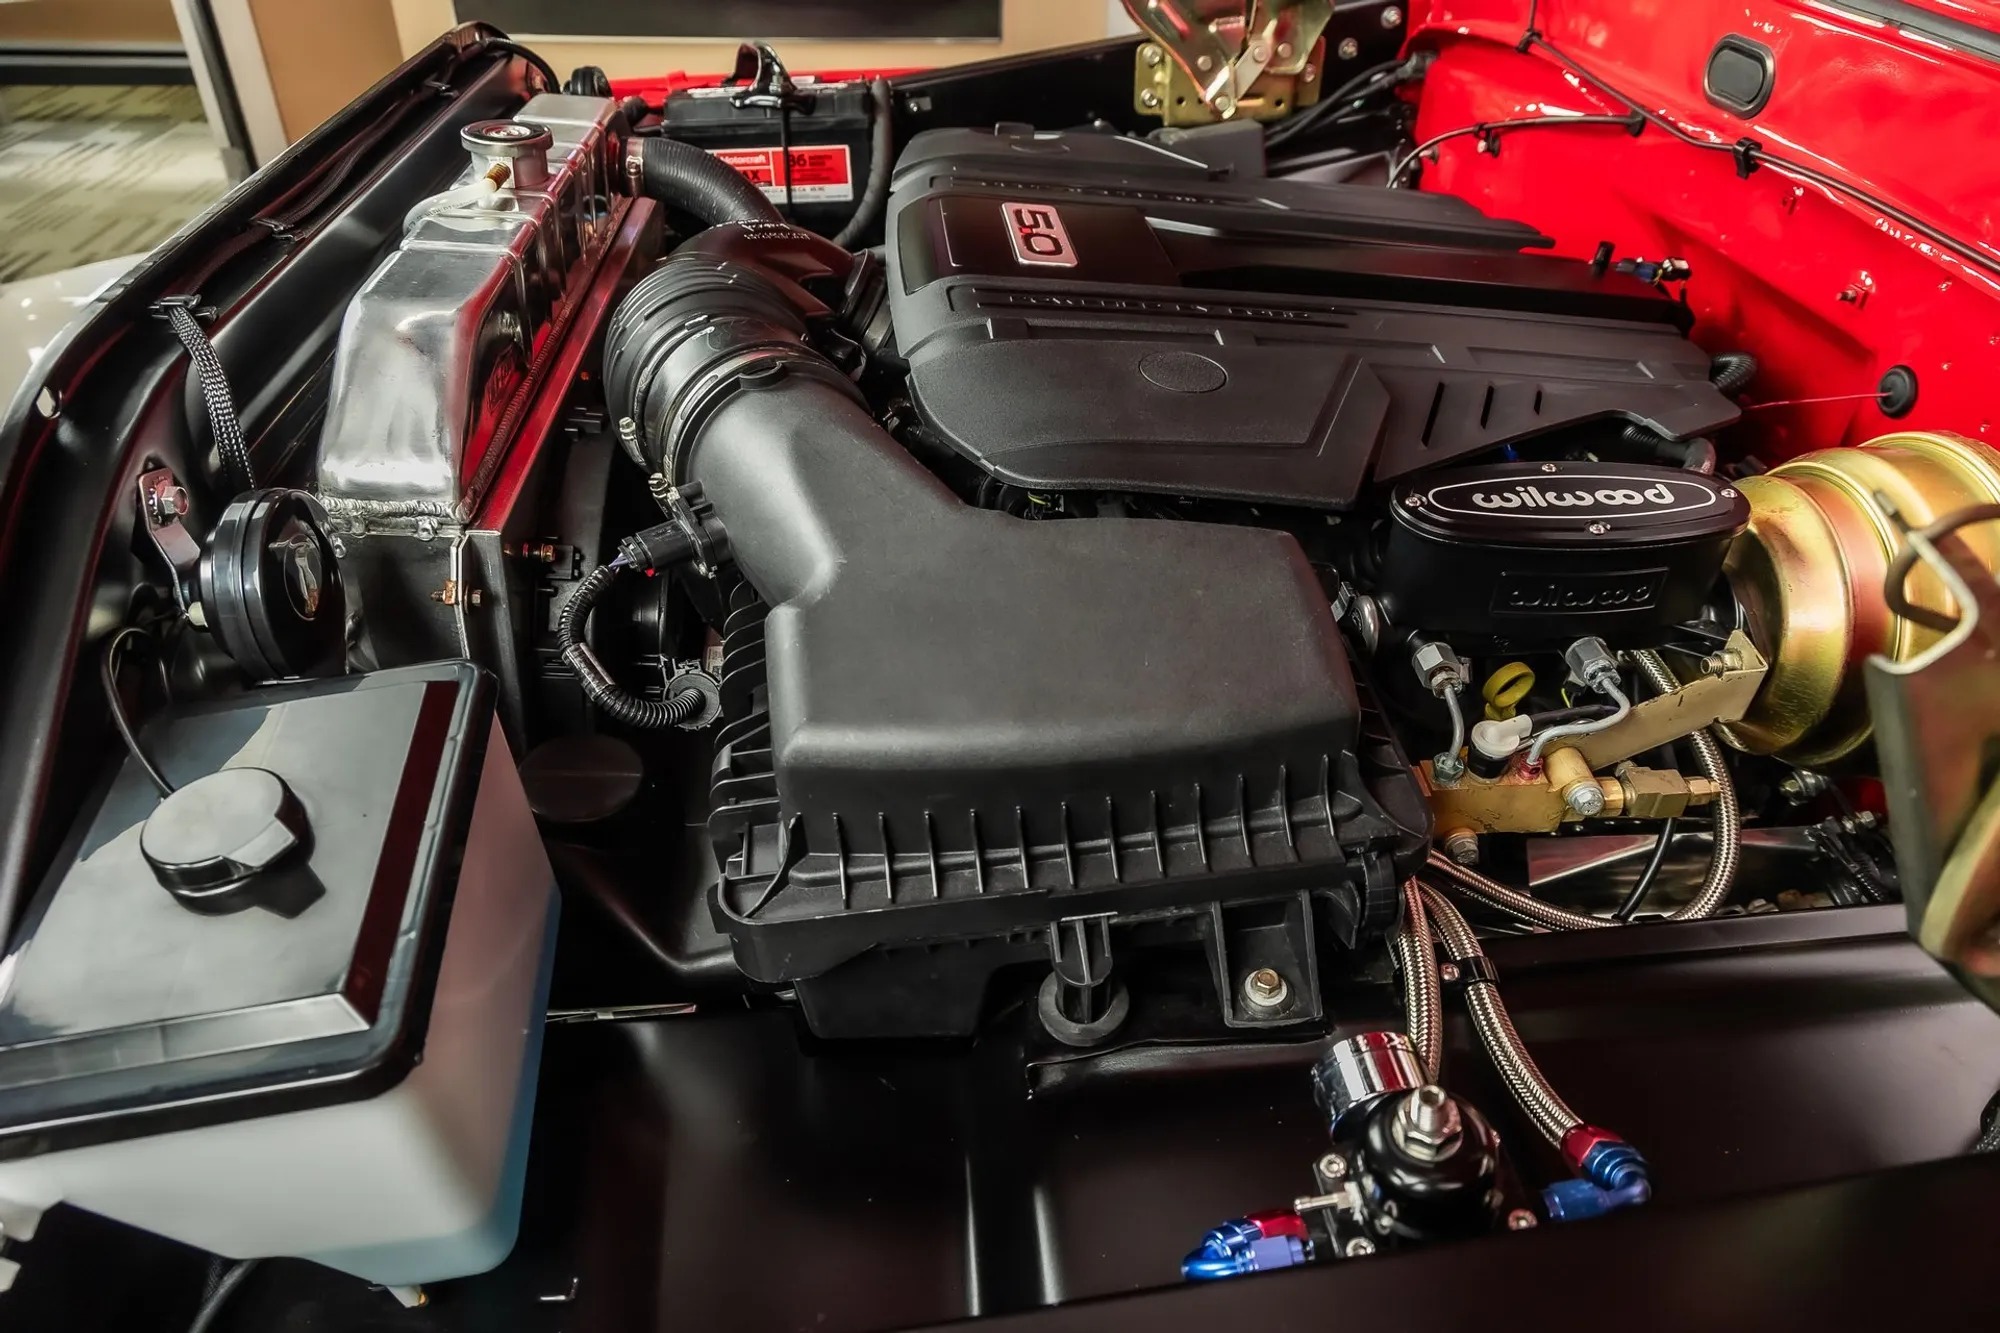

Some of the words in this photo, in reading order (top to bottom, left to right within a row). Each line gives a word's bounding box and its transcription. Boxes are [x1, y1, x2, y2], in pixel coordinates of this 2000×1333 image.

[720, 154, 766, 166] Motorcraft
[1013, 207, 1063, 256] 5.0
[1472, 483, 1675, 509] wilwood
